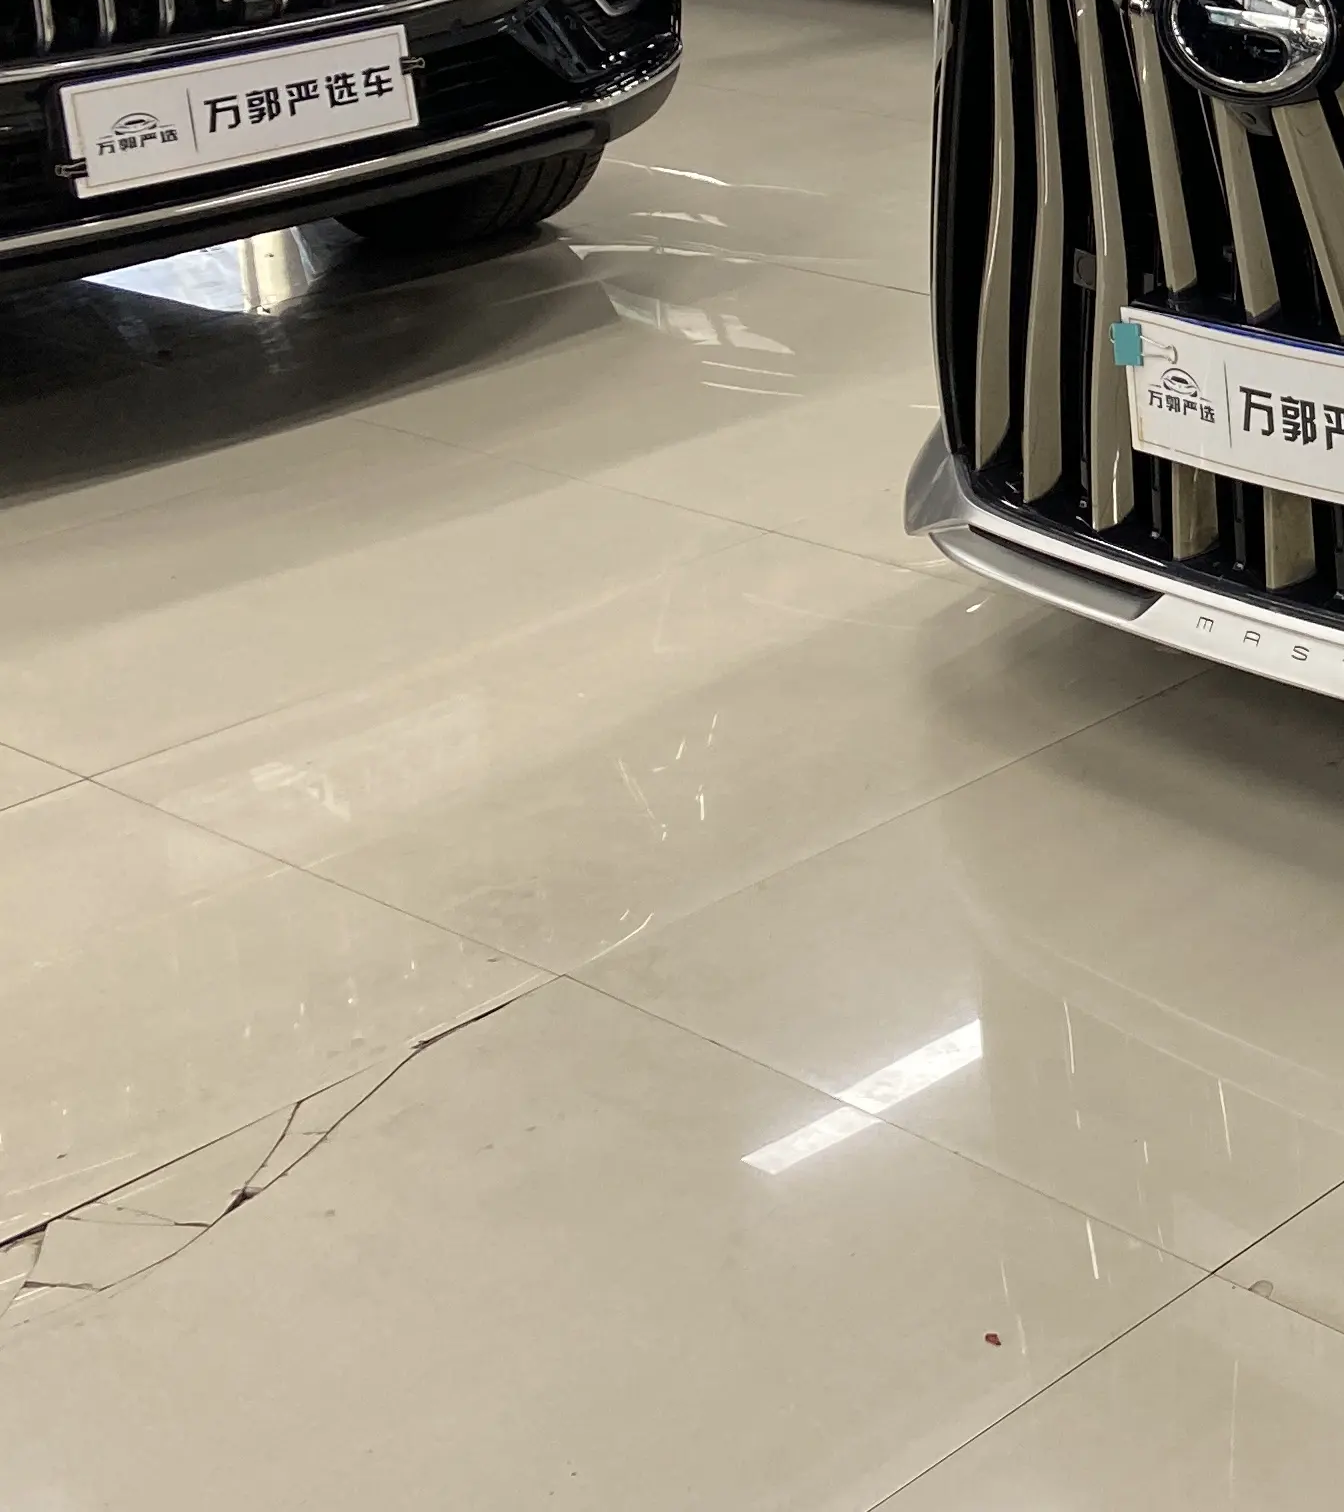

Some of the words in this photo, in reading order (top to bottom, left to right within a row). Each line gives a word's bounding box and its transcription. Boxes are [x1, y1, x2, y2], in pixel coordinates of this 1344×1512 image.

[96, 129, 178, 156] 万郭严选
[204, 65, 393, 133] 万郭严选车
[1147, 389, 1217, 424] 万郭严选
